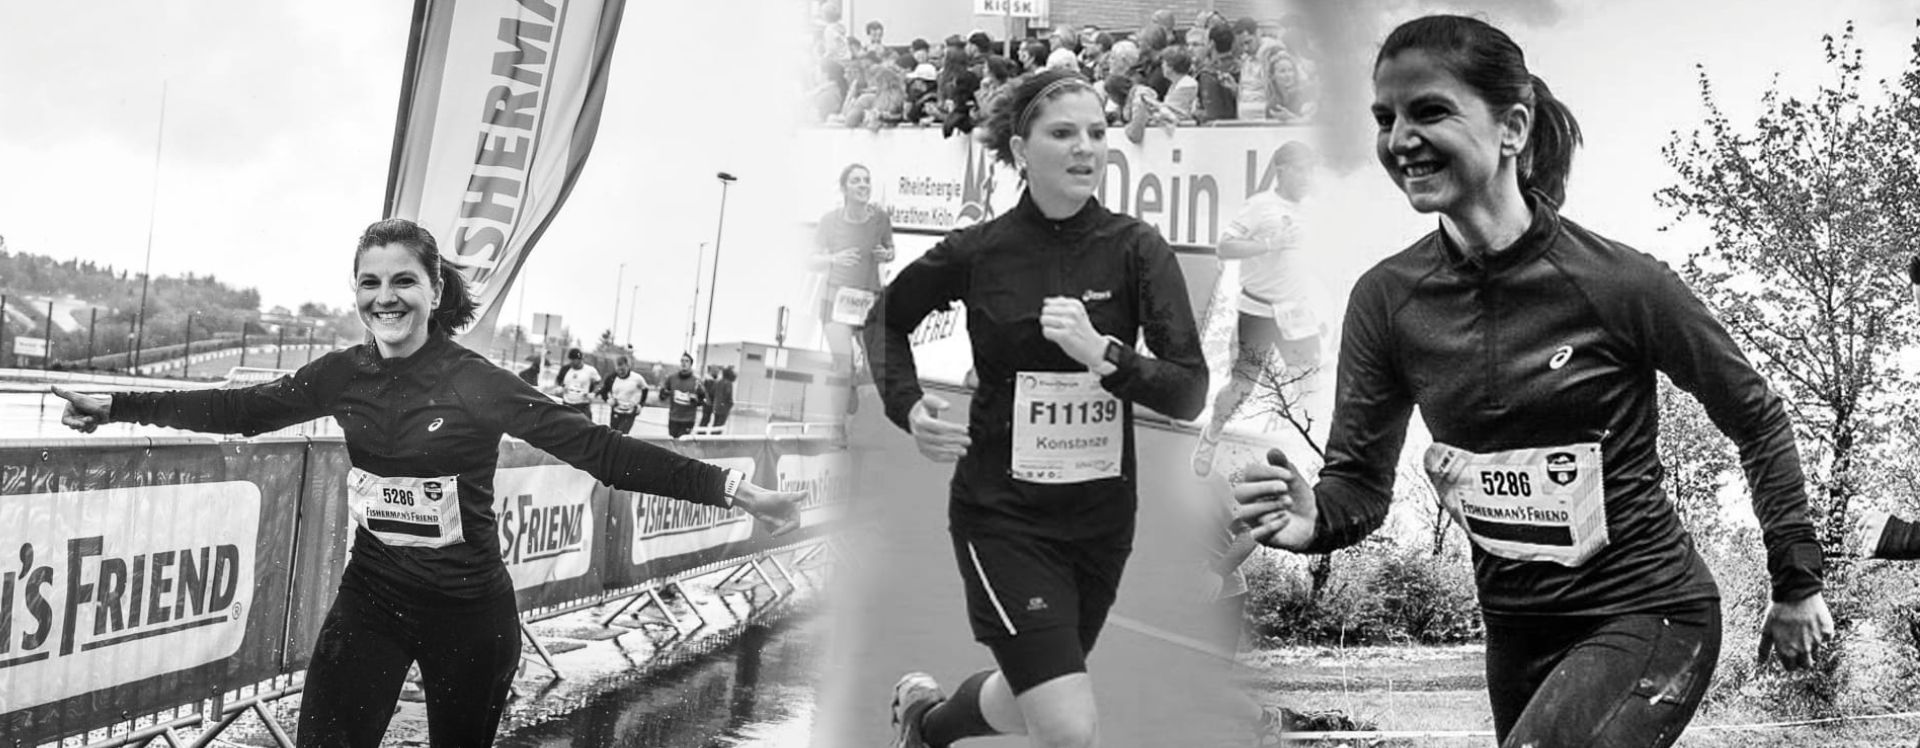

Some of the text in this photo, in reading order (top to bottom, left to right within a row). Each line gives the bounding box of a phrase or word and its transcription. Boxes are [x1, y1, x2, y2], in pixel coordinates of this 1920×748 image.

[984, 0, 1032, 13] KIOSK
[455, 0, 556, 283] SHERM
[887, 204, 930, 224] Marathon
[1029, 399, 1117, 424] F11139
[1036, 436, 1109, 450] Konstanze
[1480, 471, 1531, 497] 5286
[383, 488, 414, 507] 5286
[411, 511, 439, 523] FRIEND
[1527, 506, 1569, 522] FRIEND
[496, 494, 584, 565] 'S FRIEND
[59, 535, 240, 657] FRIEND
